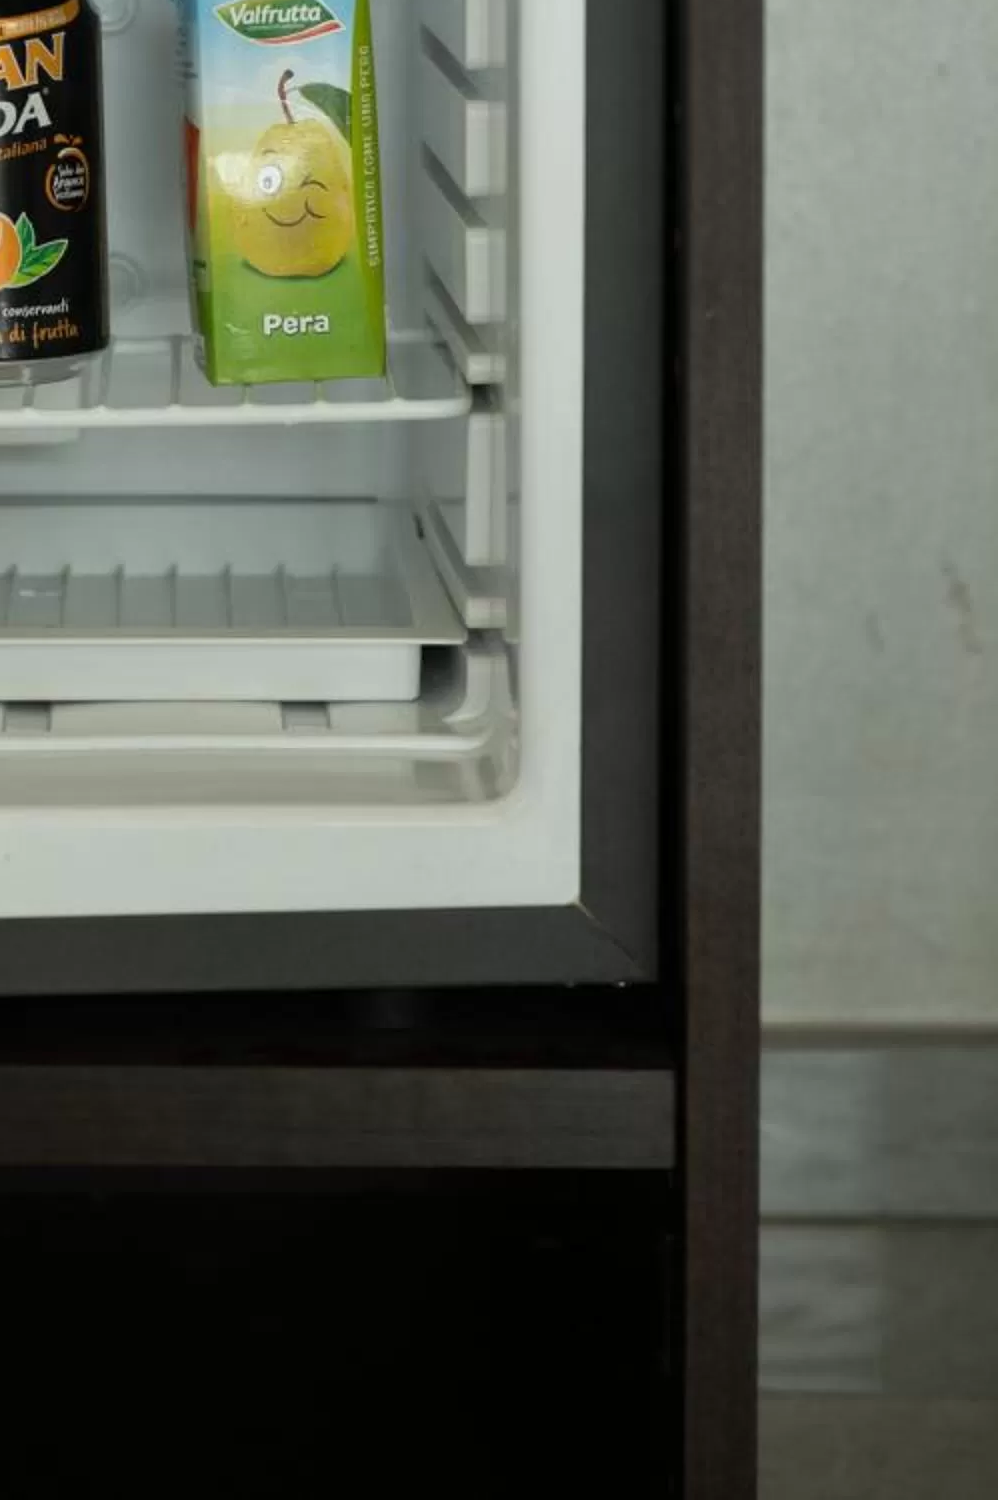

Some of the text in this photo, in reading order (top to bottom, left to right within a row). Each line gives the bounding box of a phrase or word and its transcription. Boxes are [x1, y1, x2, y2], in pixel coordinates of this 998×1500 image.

[229, 3, 322, 27] Valfrutta
[2, 297, 69, 317] conservanti
[9, 321, 26, 343] di
[33, 317, 79, 349] frutta
[263, 313, 330, 335] Pera
